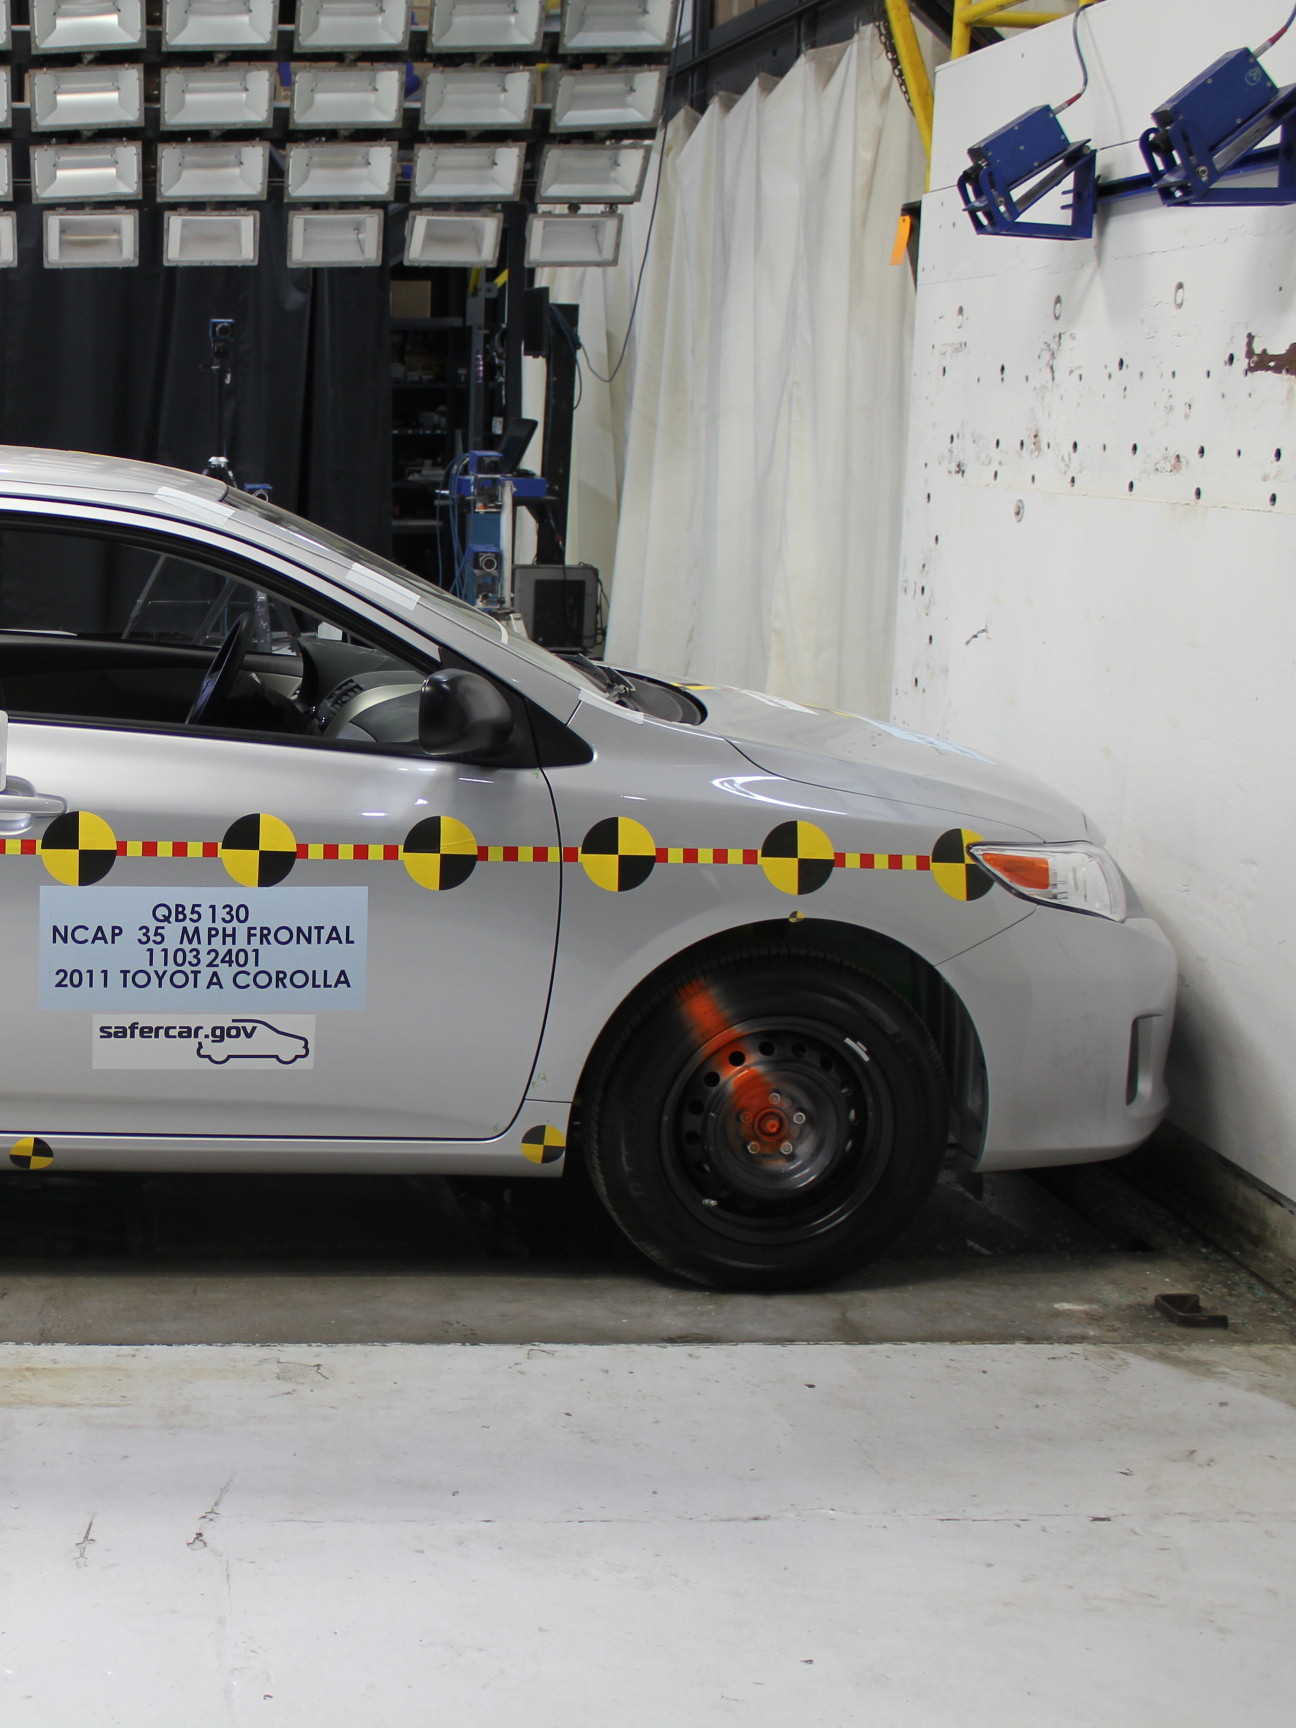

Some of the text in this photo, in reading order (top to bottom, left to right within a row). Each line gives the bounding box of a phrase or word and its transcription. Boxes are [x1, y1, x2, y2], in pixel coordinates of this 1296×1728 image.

[151, 902, 250, 925] QB5130
[51, 924, 355, 946] NCAP 35 MPH FRONTAL
[146, 947, 260, 968] 11032401
[54, 968, 352, 990] 2011 TOYOTA COROLLA
[99, 1022, 258, 1043] safercar.gov
